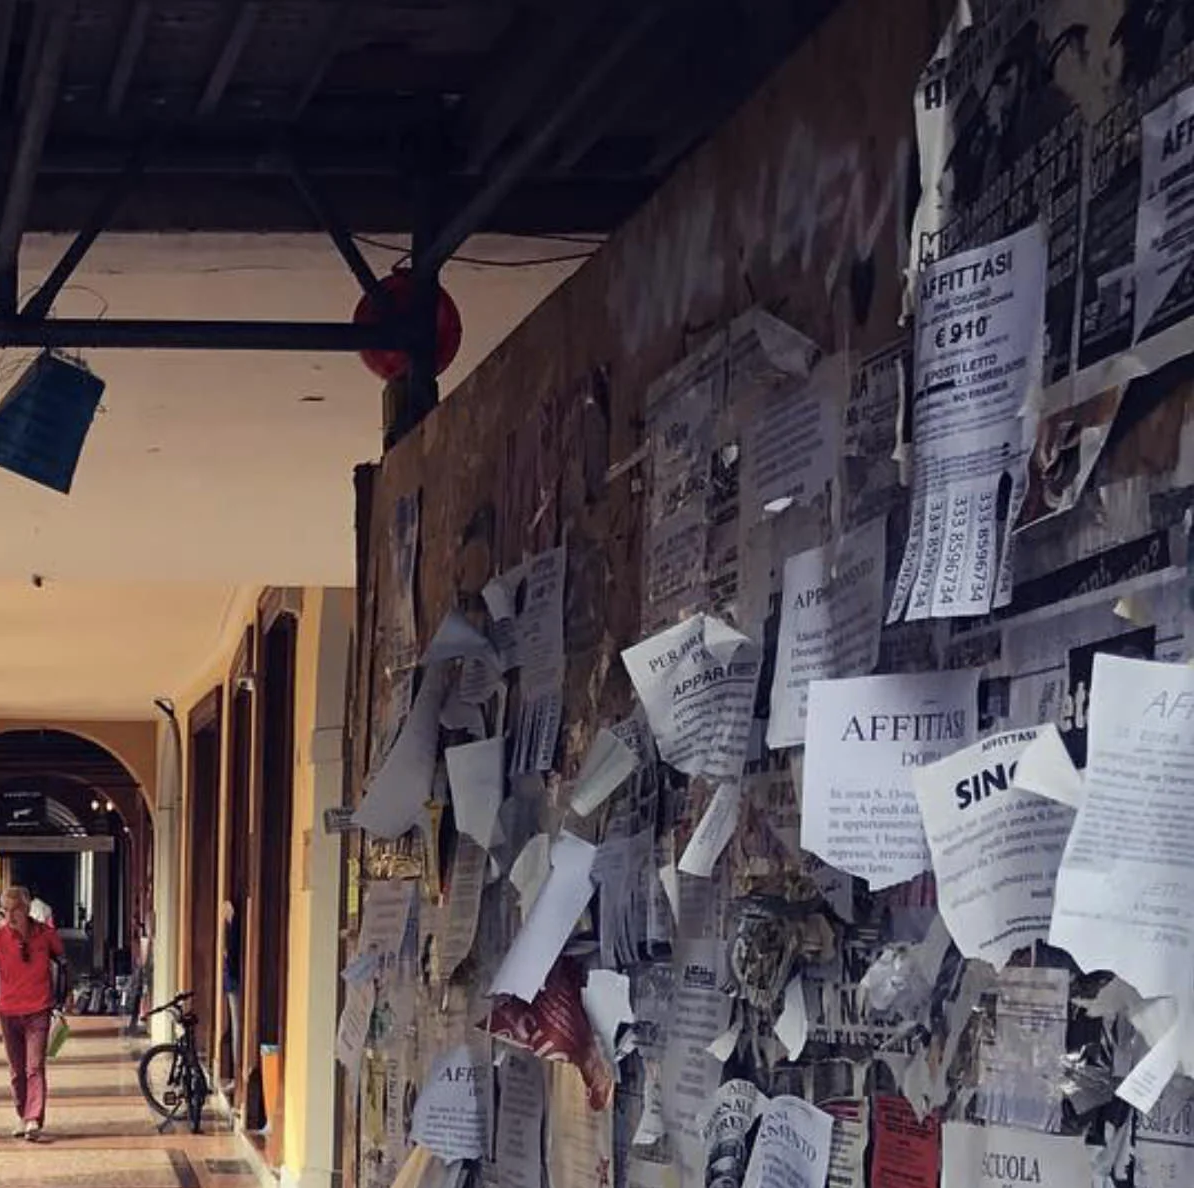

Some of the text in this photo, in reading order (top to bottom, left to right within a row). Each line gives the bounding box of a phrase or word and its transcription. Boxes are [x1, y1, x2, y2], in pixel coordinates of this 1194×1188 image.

[920, 250, 1013, 301] AFFITTASI
[840, 708, 966, 742] AFFITTASI
[981, 730, 1037, 752] AFFITTASI
[982, 1151, 1042, 1184] SCUOLA
